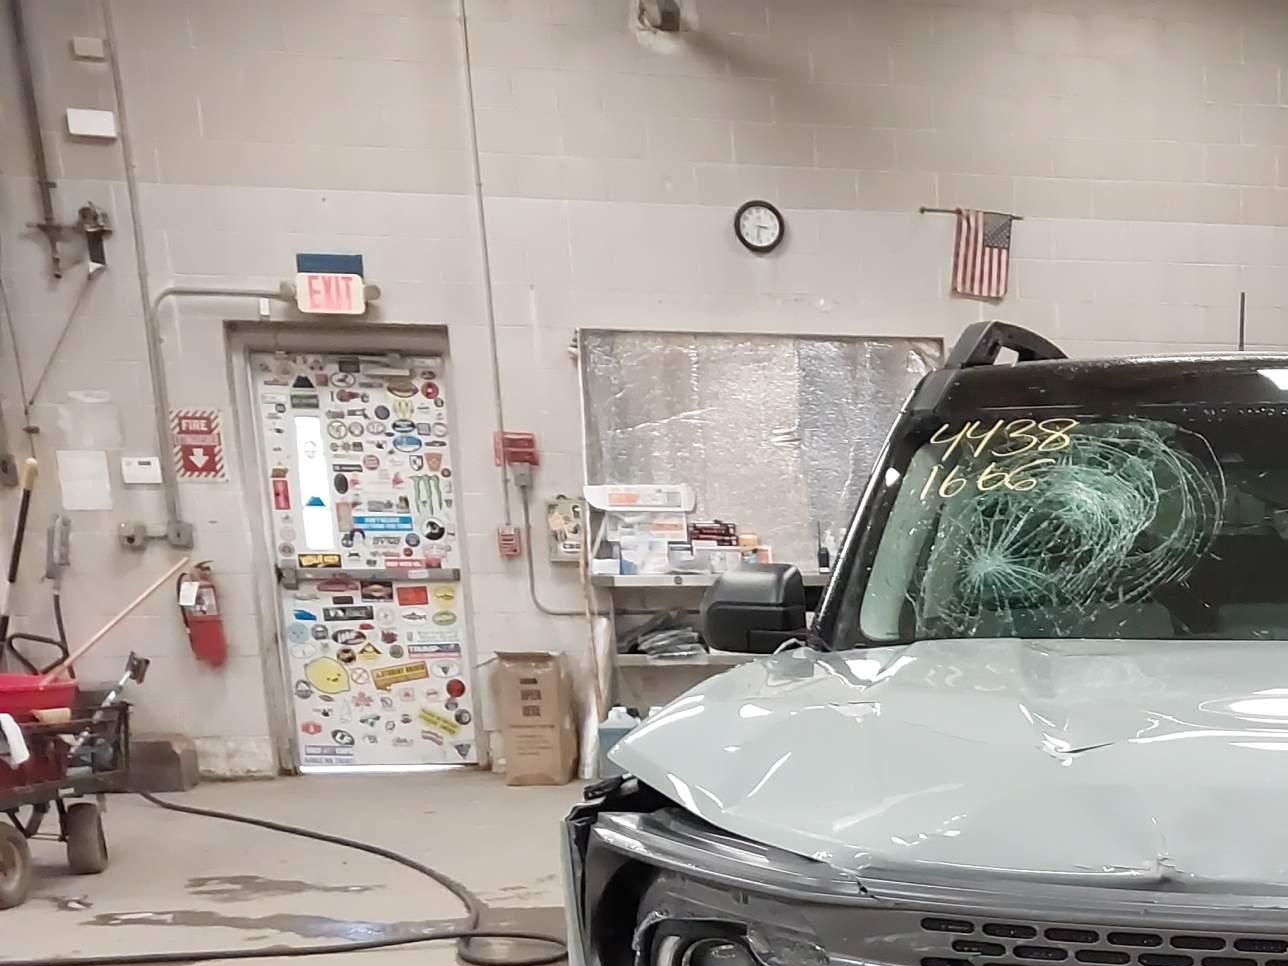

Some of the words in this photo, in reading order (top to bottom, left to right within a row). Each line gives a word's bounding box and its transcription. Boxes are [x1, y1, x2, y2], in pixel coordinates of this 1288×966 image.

[308, 276, 352, 311] EXIT
[182, 419, 208, 431] FIRE
[930, 418, 1080, 462] 4438
[920, 458, 1057, 501] 1666
